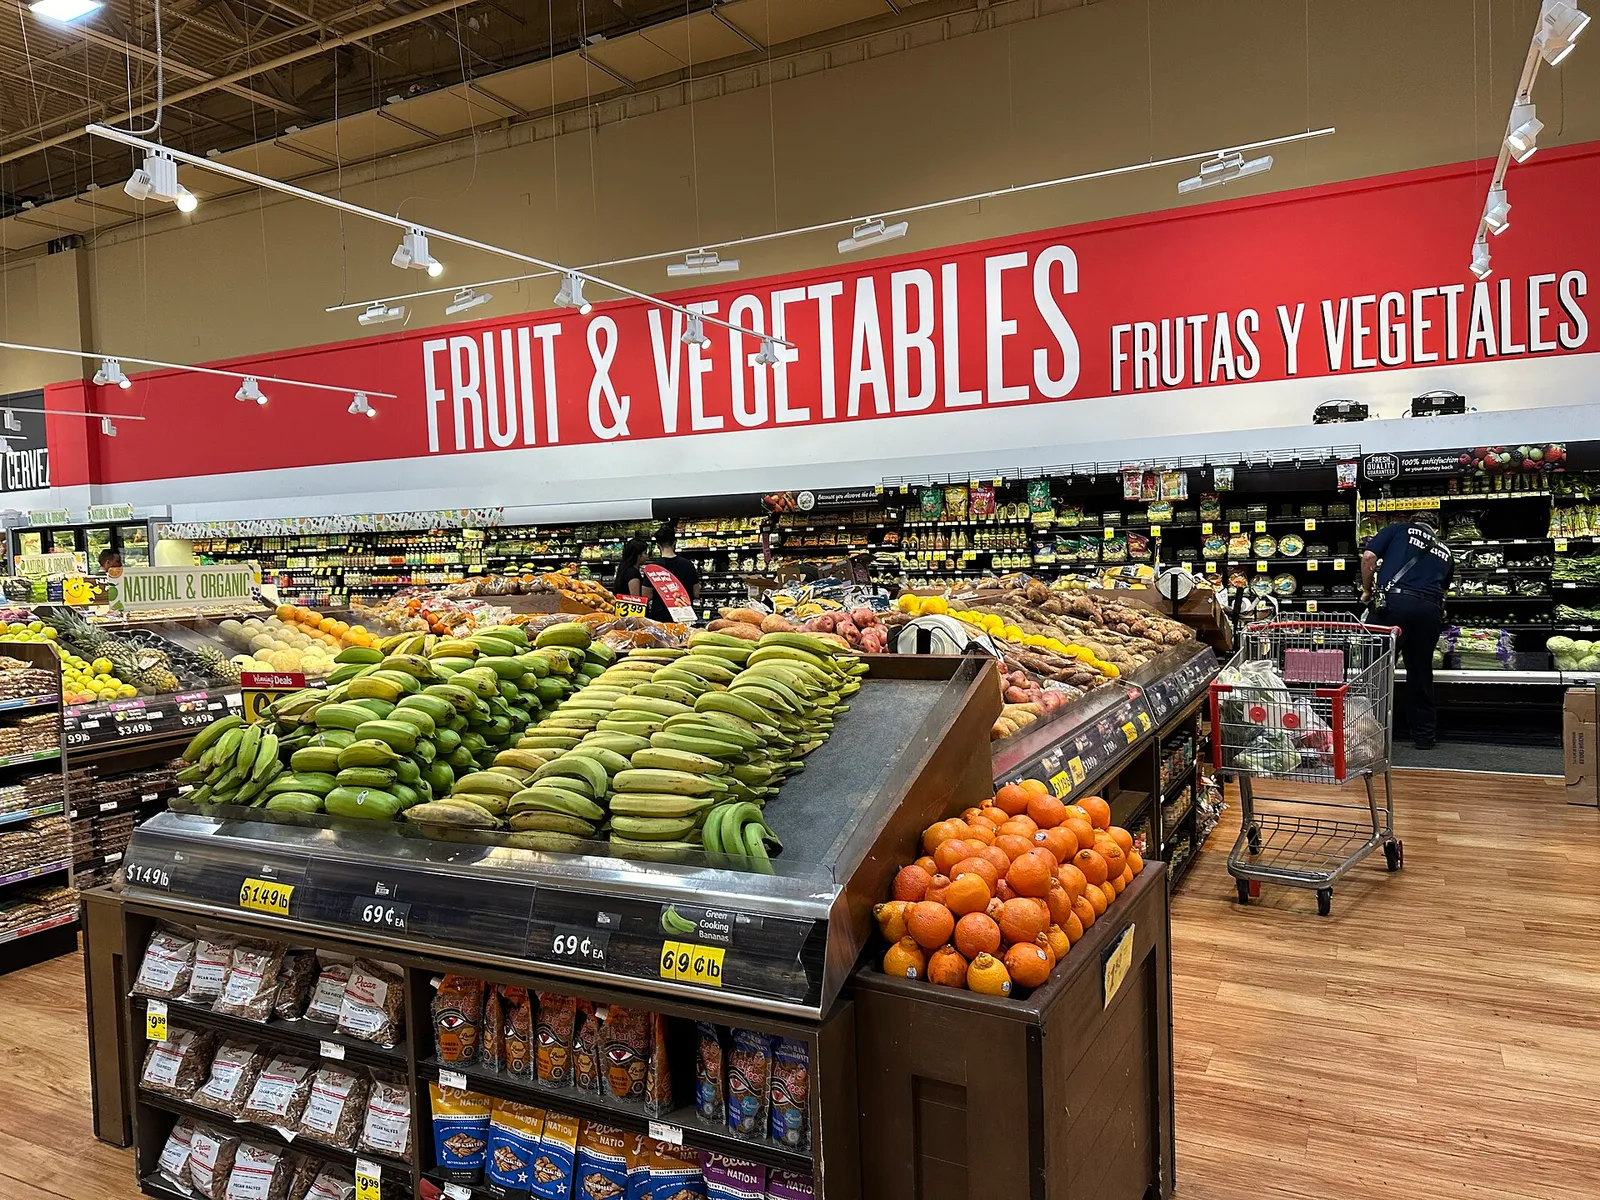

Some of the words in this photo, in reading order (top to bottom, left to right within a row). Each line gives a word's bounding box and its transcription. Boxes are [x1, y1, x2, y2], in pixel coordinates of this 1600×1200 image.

[1110, 307, 1260, 392] FRUTAS
[1276, 302, 1304, 376] Y
[1321, 270, 1589, 373] VEGETALES
[422, 322, 563, 453] FRUIT
[585, 314, 631, 441] &
[647, 245, 1080, 434] VEGETABLES
[1367, 461, 1395, 470] QUALITY
[1401, 458, 1420, 466] 100%
[1421, 455, 1459, 465] satisfaction
[1407, 528, 1422, 536] CITY
[1422, 532, 1431, 541] OF
[26, 558, 45, 573] NATURAL
[54, 557, 75, 572] ORGANIC
[123, 573, 181, 603] NATURAL
[186, 572, 196, 600] &
[200, 571, 250, 600] ORGANIC
[253, 673, 275, 688] Winning
[274, 675, 292, 685] Deals
[181, 714, 214, 727] $3.49lb
[117, 722, 153, 736] $3.49lb
[126, 863, 169, 886] $1.49lb
[241, 885, 288, 909] $1.49lb
[705, 909, 728, 920] Green
[394, 918, 405, 928] EA
[699, 920, 729, 933] Cooking
[698, 930, 729, 942] Bananas
[160, 937, 184, 950] Peca
[204, 943, 231, 952] Pecan
[592, 949, 604, 960] EA
[354, 975, 377, 989] Pecan
[459, 1098, 490, 1107] NATION
[514, 1112, 538, 1126] NATION
[547, 1121, 573, 1137] NATION
[599, 1135, 625, 1148] NATIO
[680, 1151, 699, 1160] NAT
[726, 1168, 757, 1184] NATION
[786, 1180, 813, 1195] NATIO
